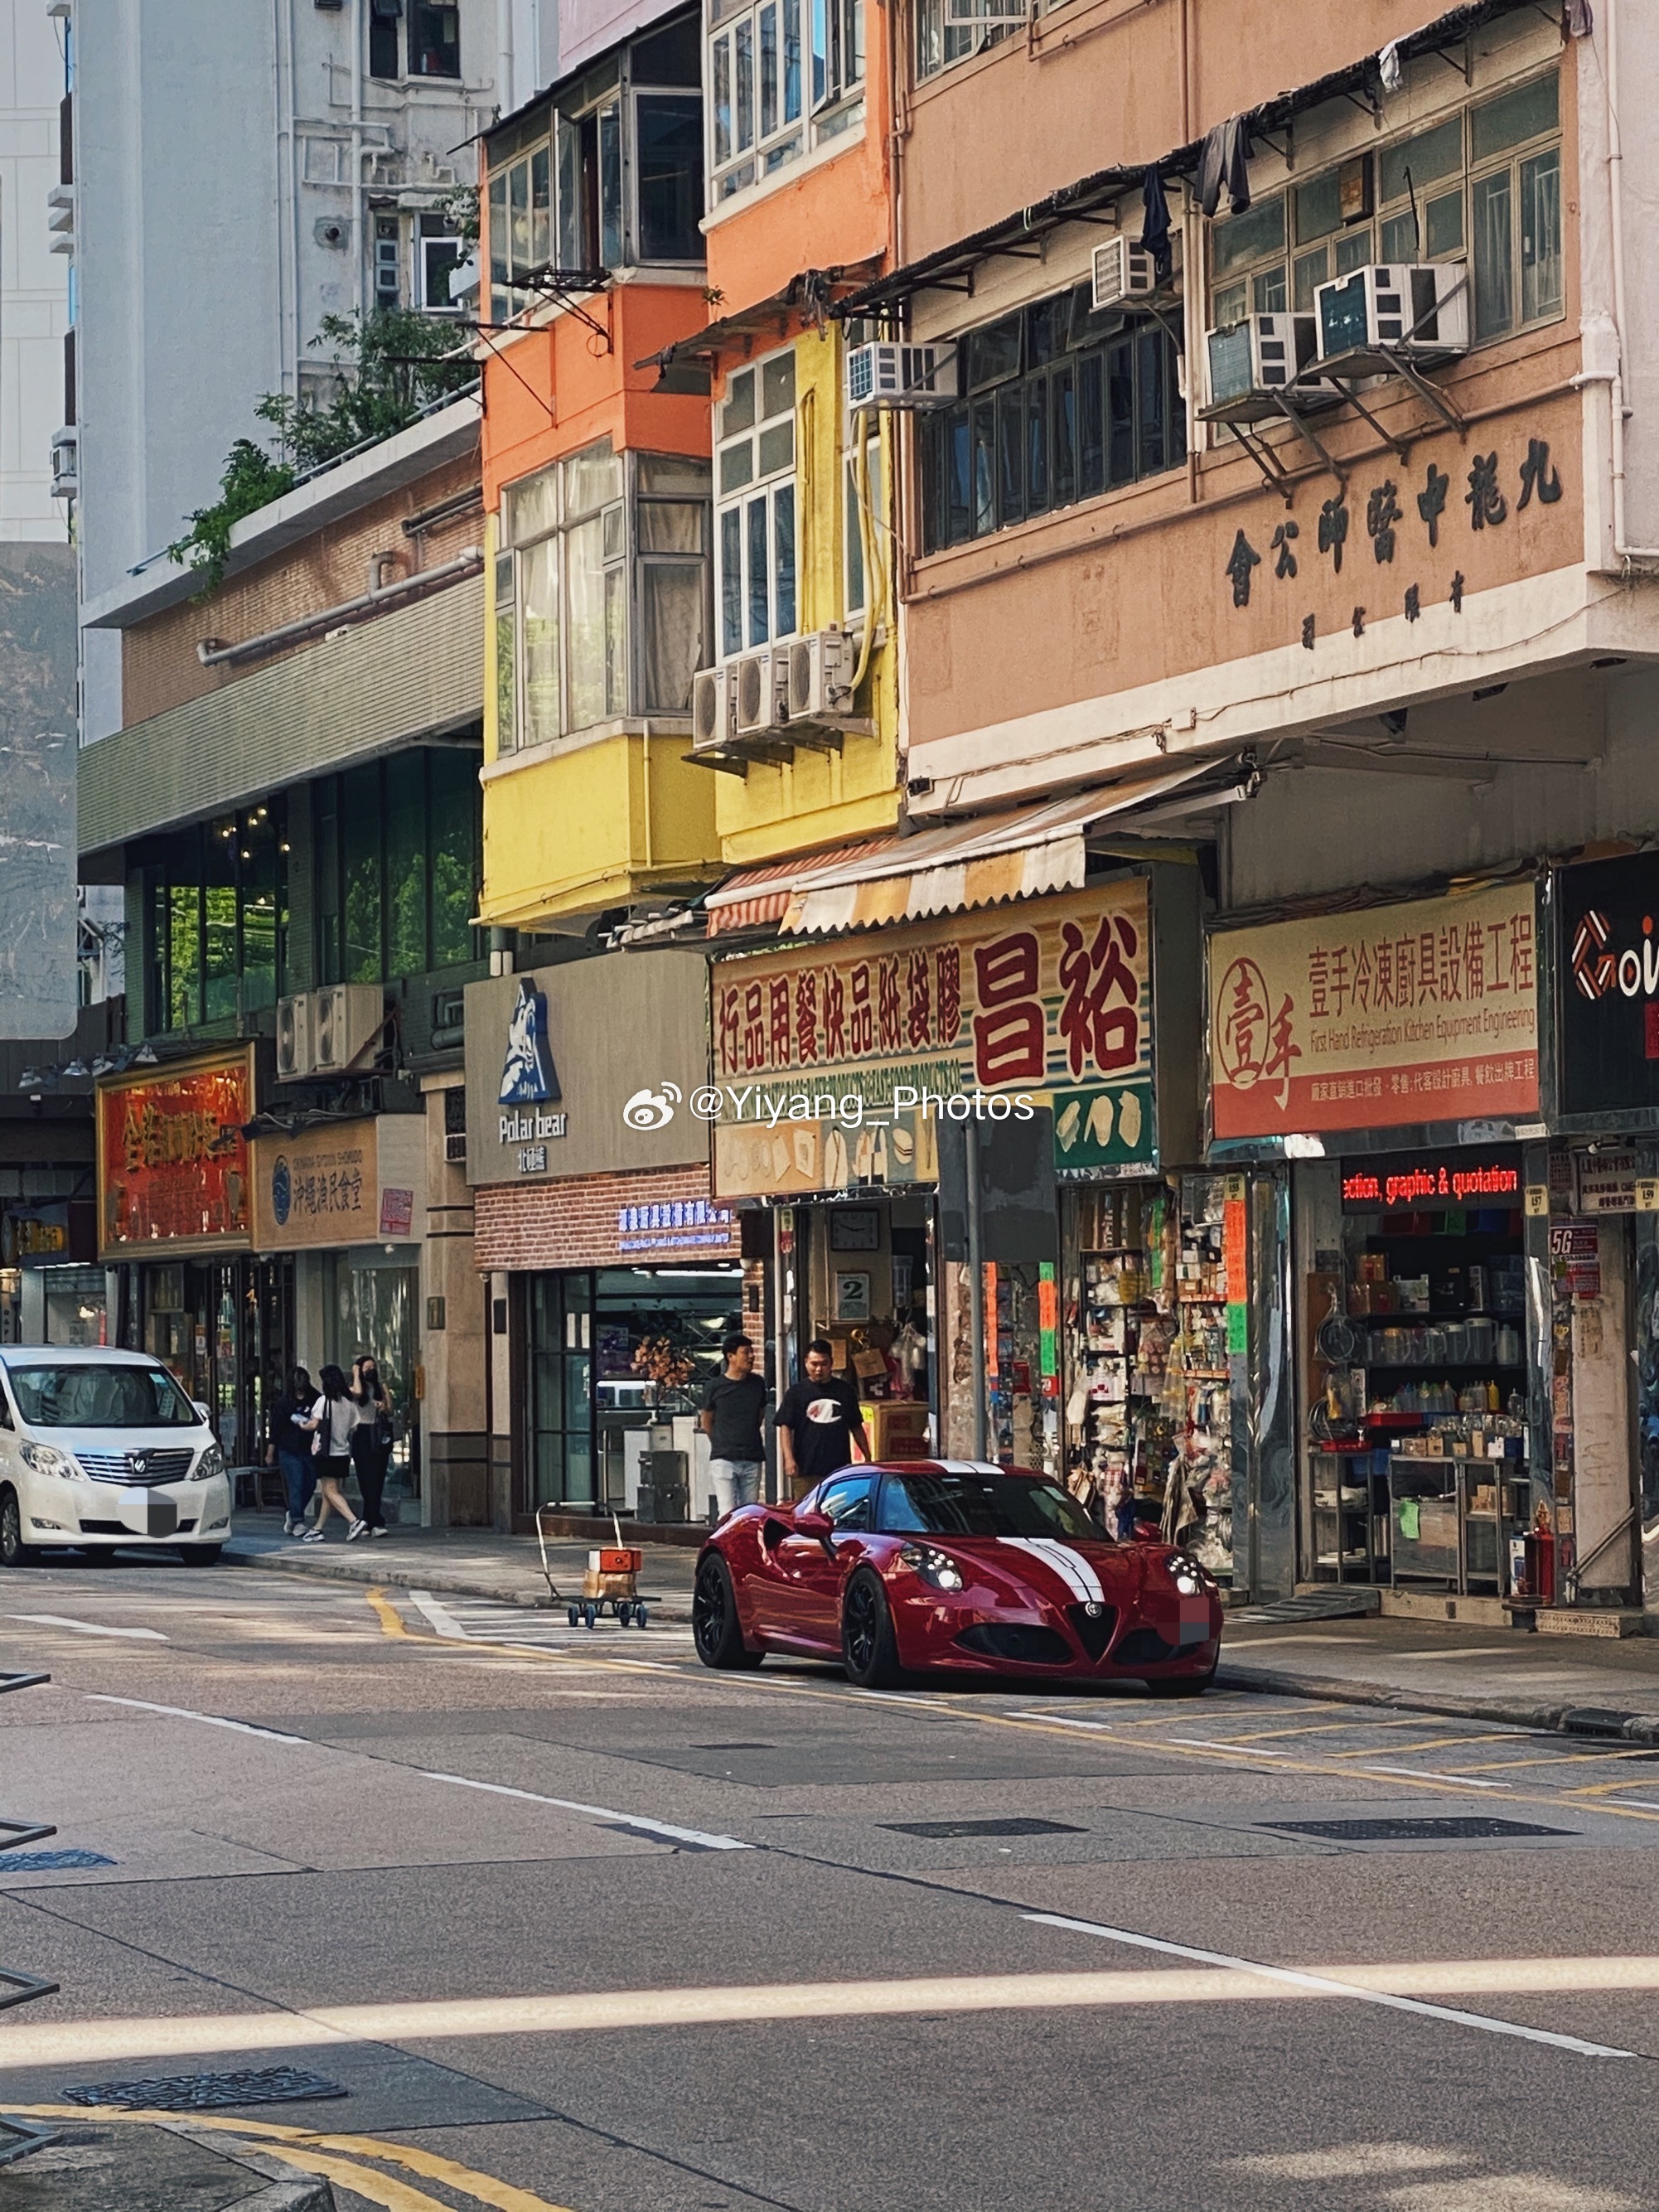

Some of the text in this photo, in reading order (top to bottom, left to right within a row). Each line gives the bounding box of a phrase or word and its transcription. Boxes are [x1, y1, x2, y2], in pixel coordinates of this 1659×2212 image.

[1226, 438, 1562, 608] 九龍中醫師公會
[1309, 912, 1534, 1018] 壹手冷凍廚具設備工程
[972, 914, 1139, 1087] 裕昌
[1310, 1008, 1534, 1054] First Hand Refrigeration Kitchen Equipment Engineering
[499, 1106, 568, 1144] Polar bear
[1386, 1169, 1435, 1206] graphic
[1438, 1167, 1449, 1194] &
[1453, 1165, 1517, 1200] quotation
[1551, 1229, 1573, 1254] 5G
[843, 1280, 863, 1300] 2
